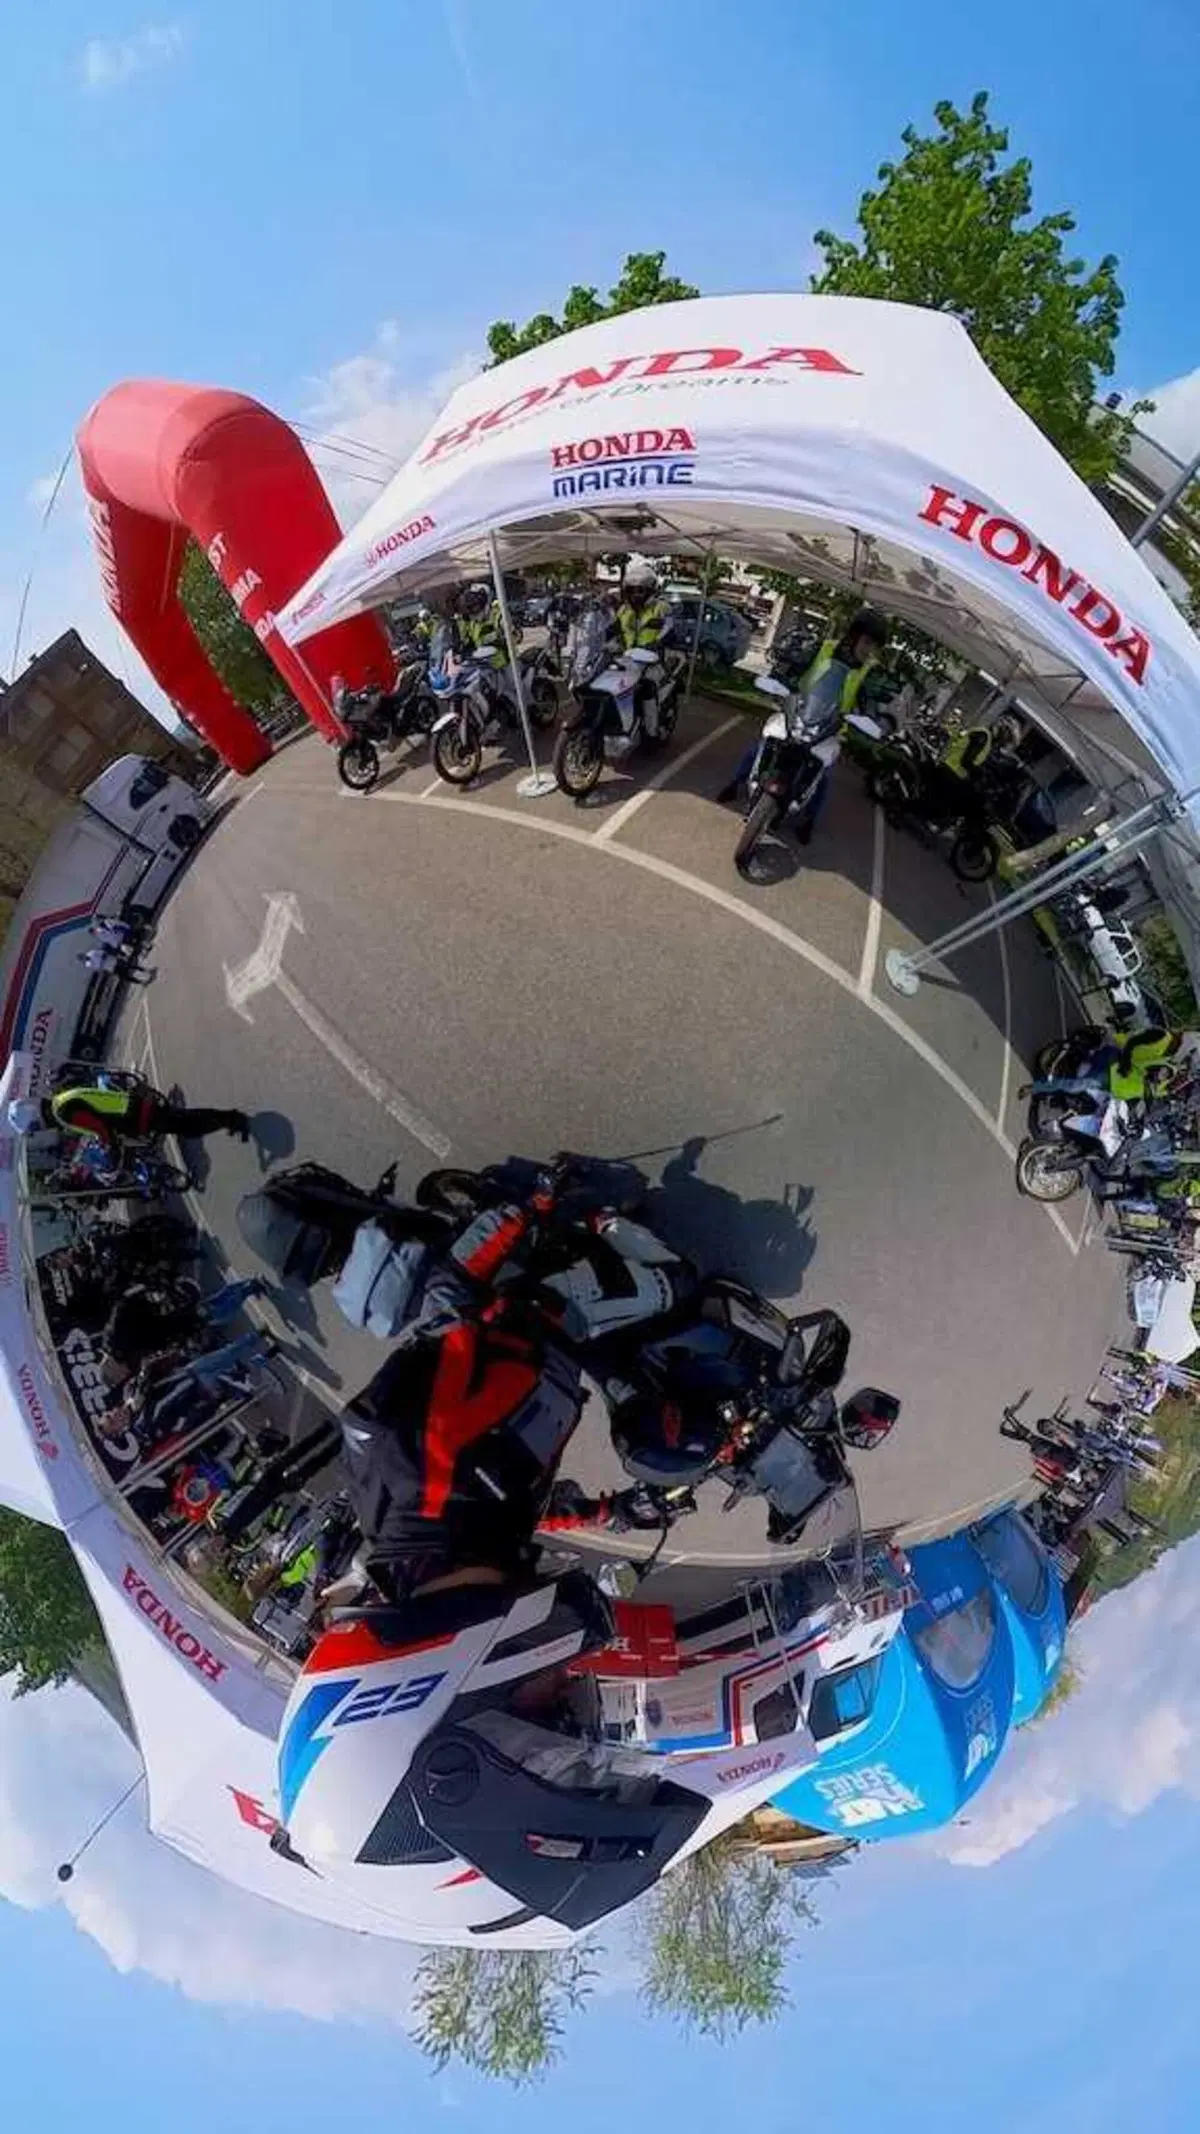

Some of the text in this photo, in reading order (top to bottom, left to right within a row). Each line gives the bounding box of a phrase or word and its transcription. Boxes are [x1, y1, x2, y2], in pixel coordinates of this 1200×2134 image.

[417, 346, 864, 465] HONDA
[550, 427, 697, 467] HONDA
[374, 515, 436, 559] HONDA
[919, 485, 1152, 686] HONDA
[17, 1362, 50, 1438] HONDA
[123, 1562, 229, 1682] HONDA
[332, 1670, 449, 1727] 23
[716, 1756, 772, 1783] HONDA
[814, 1762, 897, 1801] SERIES
